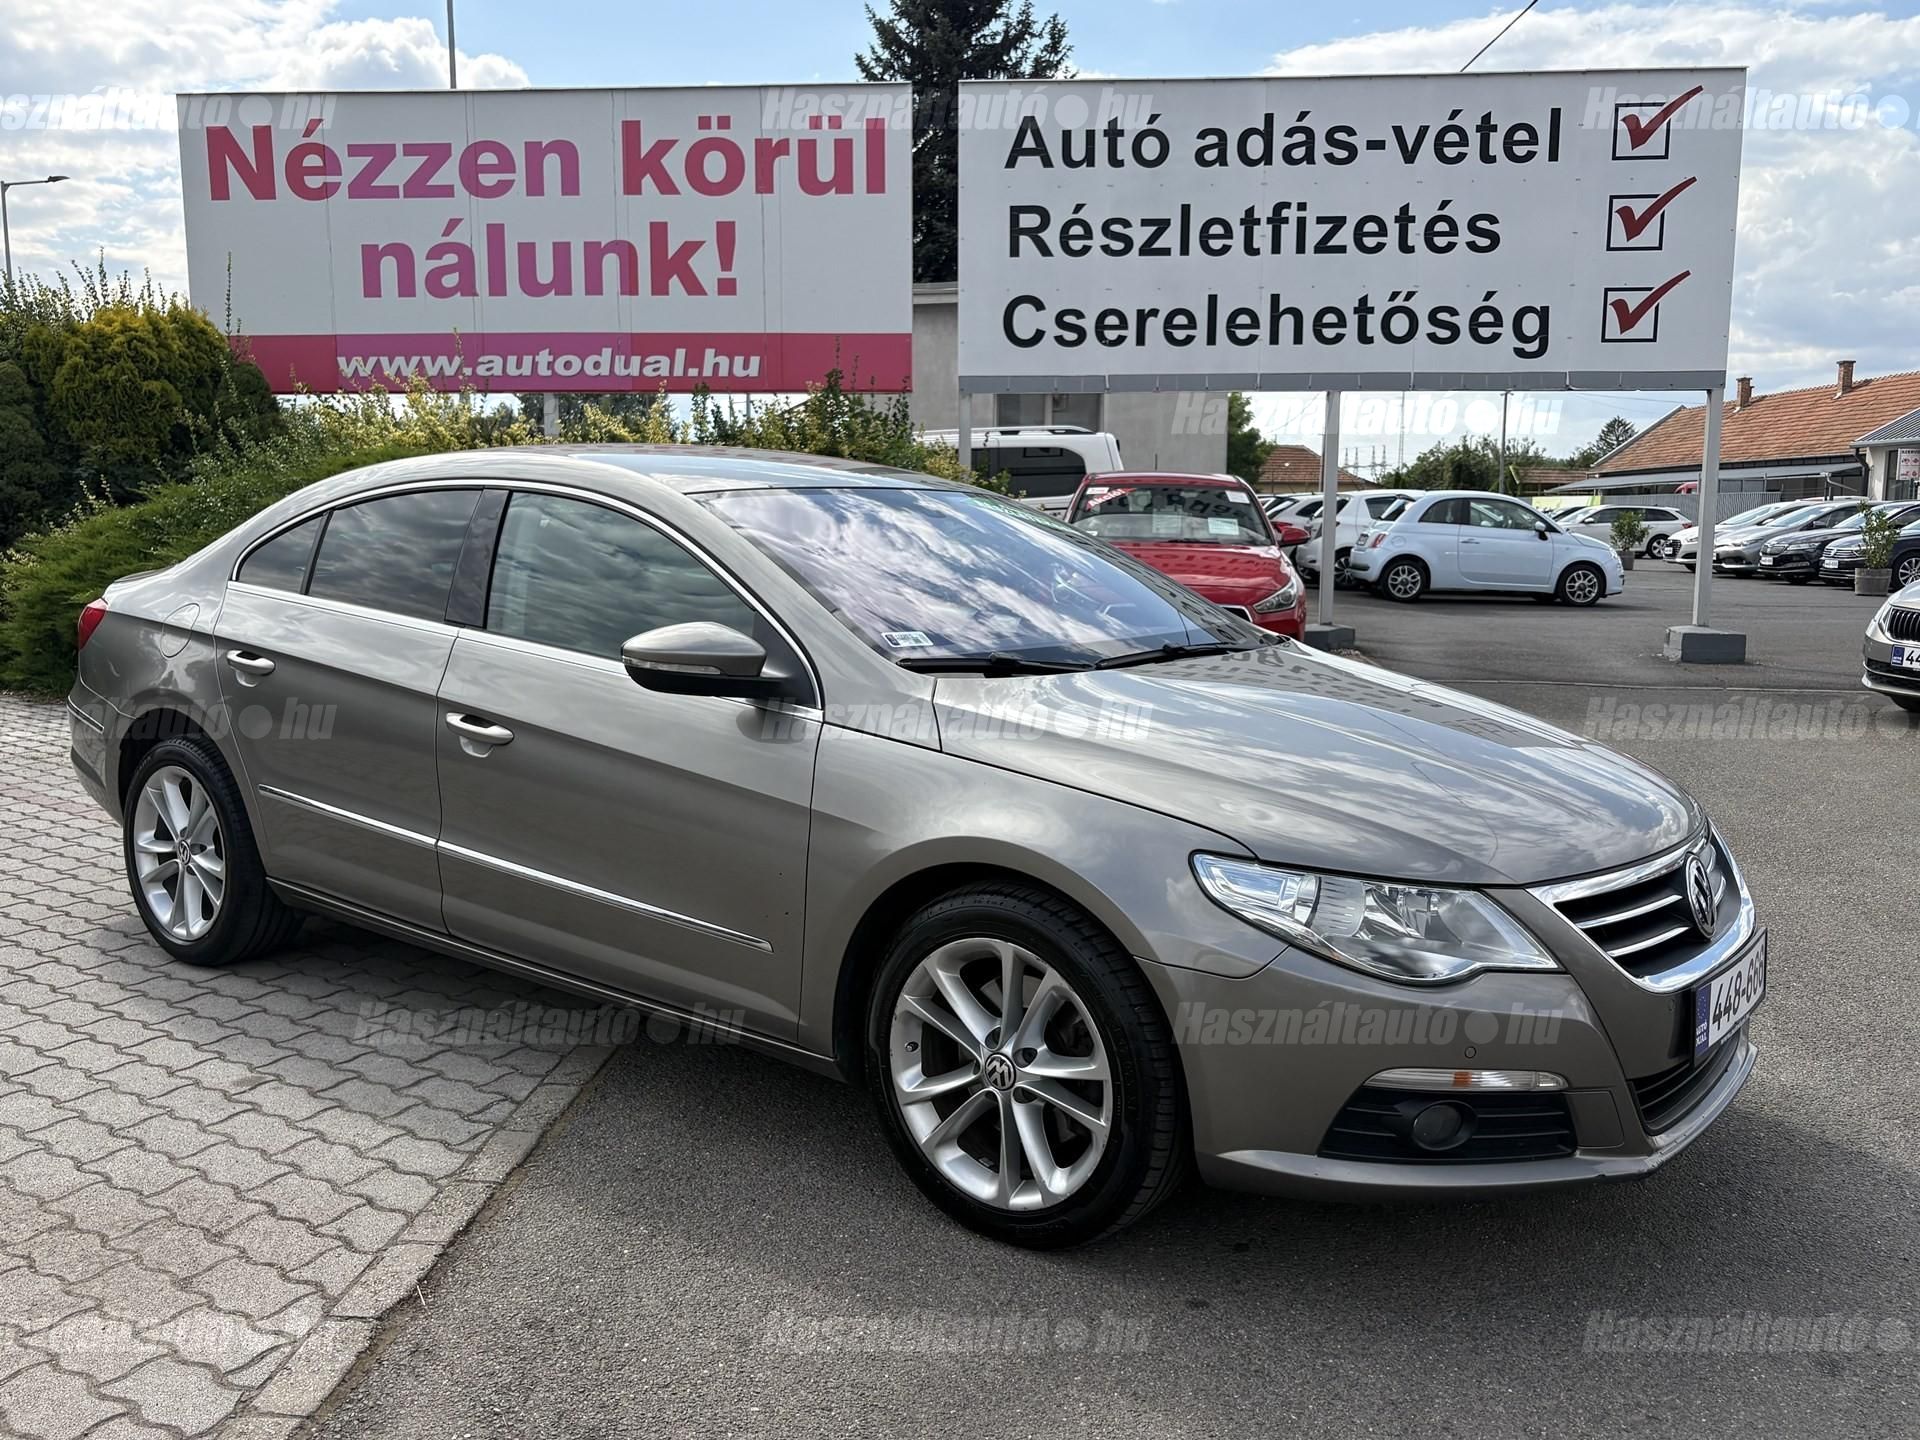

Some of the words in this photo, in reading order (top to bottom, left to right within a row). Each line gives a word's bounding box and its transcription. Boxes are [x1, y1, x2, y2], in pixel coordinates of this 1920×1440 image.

[206, 118, 581, 201] Nézzen
[621, 115, 888, 198] körül
[1004, 113, 1170, 170] Autó
[1194, 107, 1562, 166] adás-vétel
[361, 218, 739, 299] nálunk!
[1009, 199, 1502, 258] Részletfizetés
[1001, 289, 1551, 359] Cserelehetőség
[336, 347, 761, 378] www.autodual.hu
